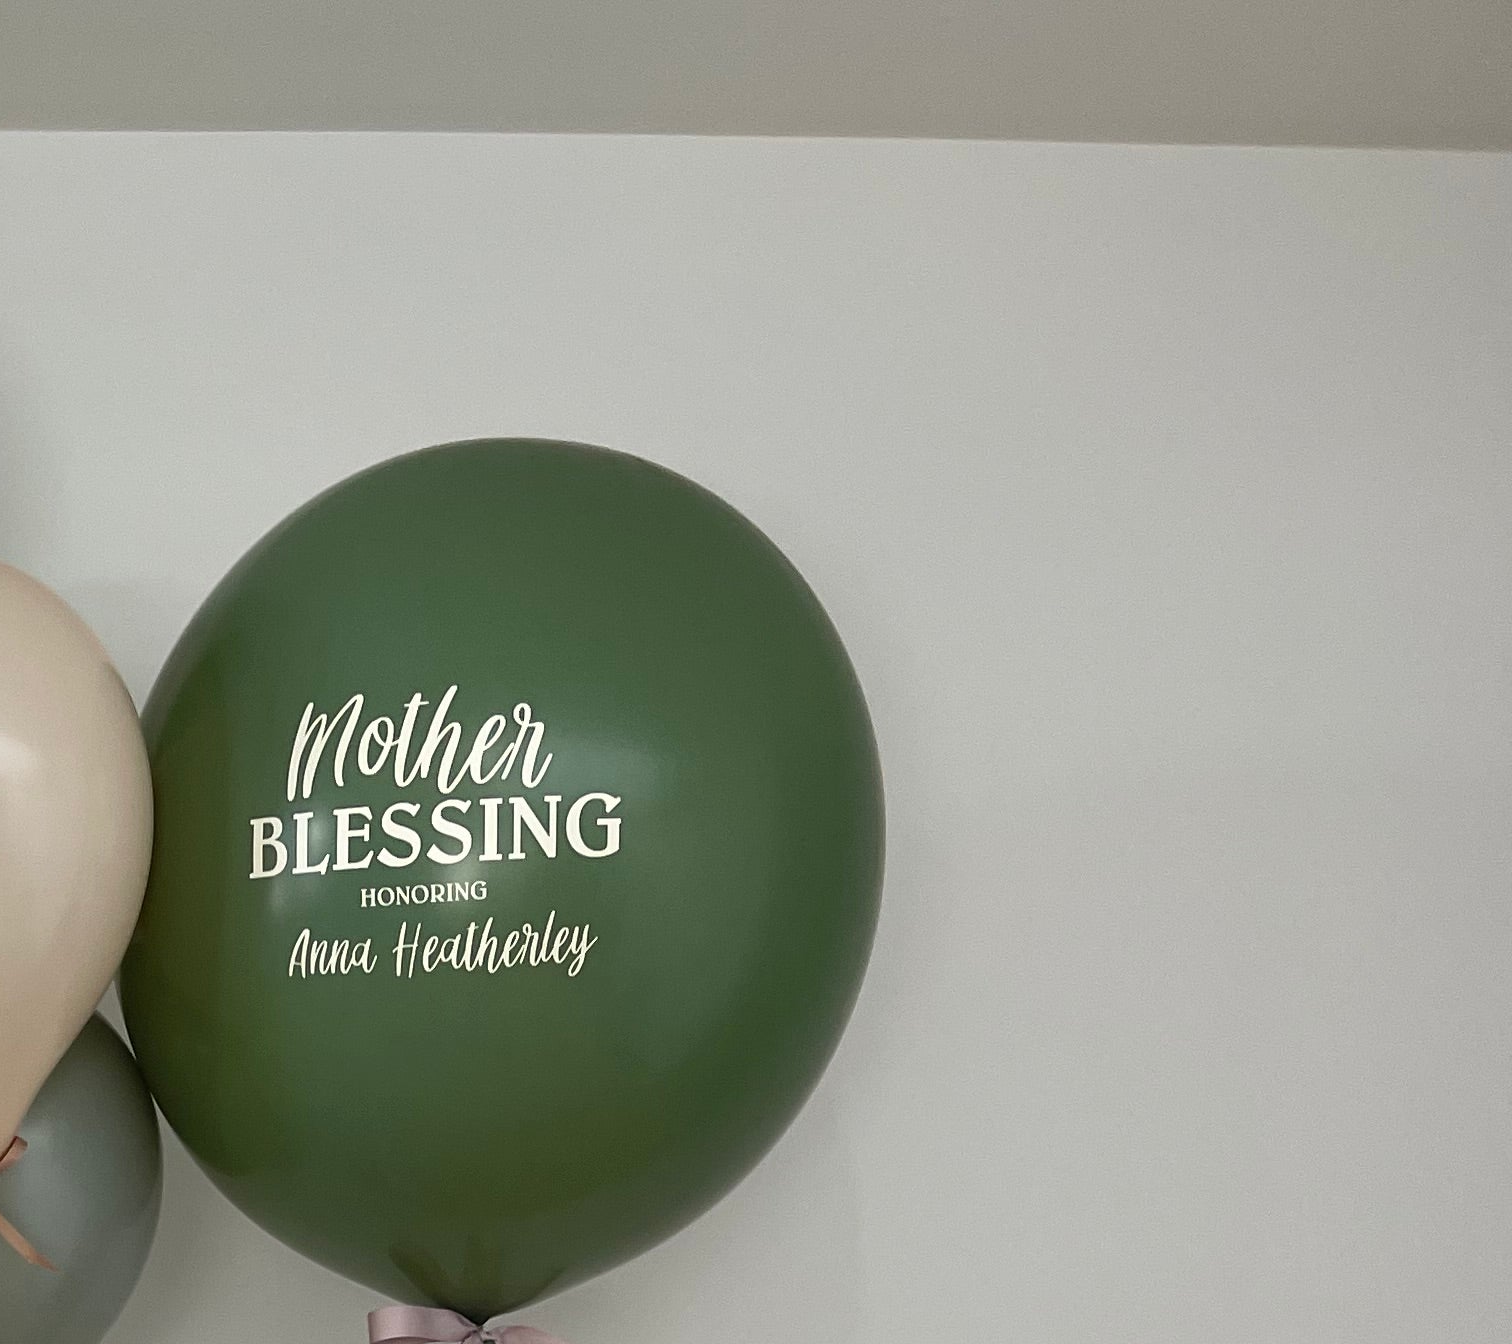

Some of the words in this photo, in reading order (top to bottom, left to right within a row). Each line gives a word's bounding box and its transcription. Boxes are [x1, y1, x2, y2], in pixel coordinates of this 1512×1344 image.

[287, 684, 554, 802] Mother
[249, 792, 623, 880] BLESSING
[360, 880, 489, 908] HONORING
[288, 928, 378, 979] Anna
[392, 910, 599, 979] Heatherley
